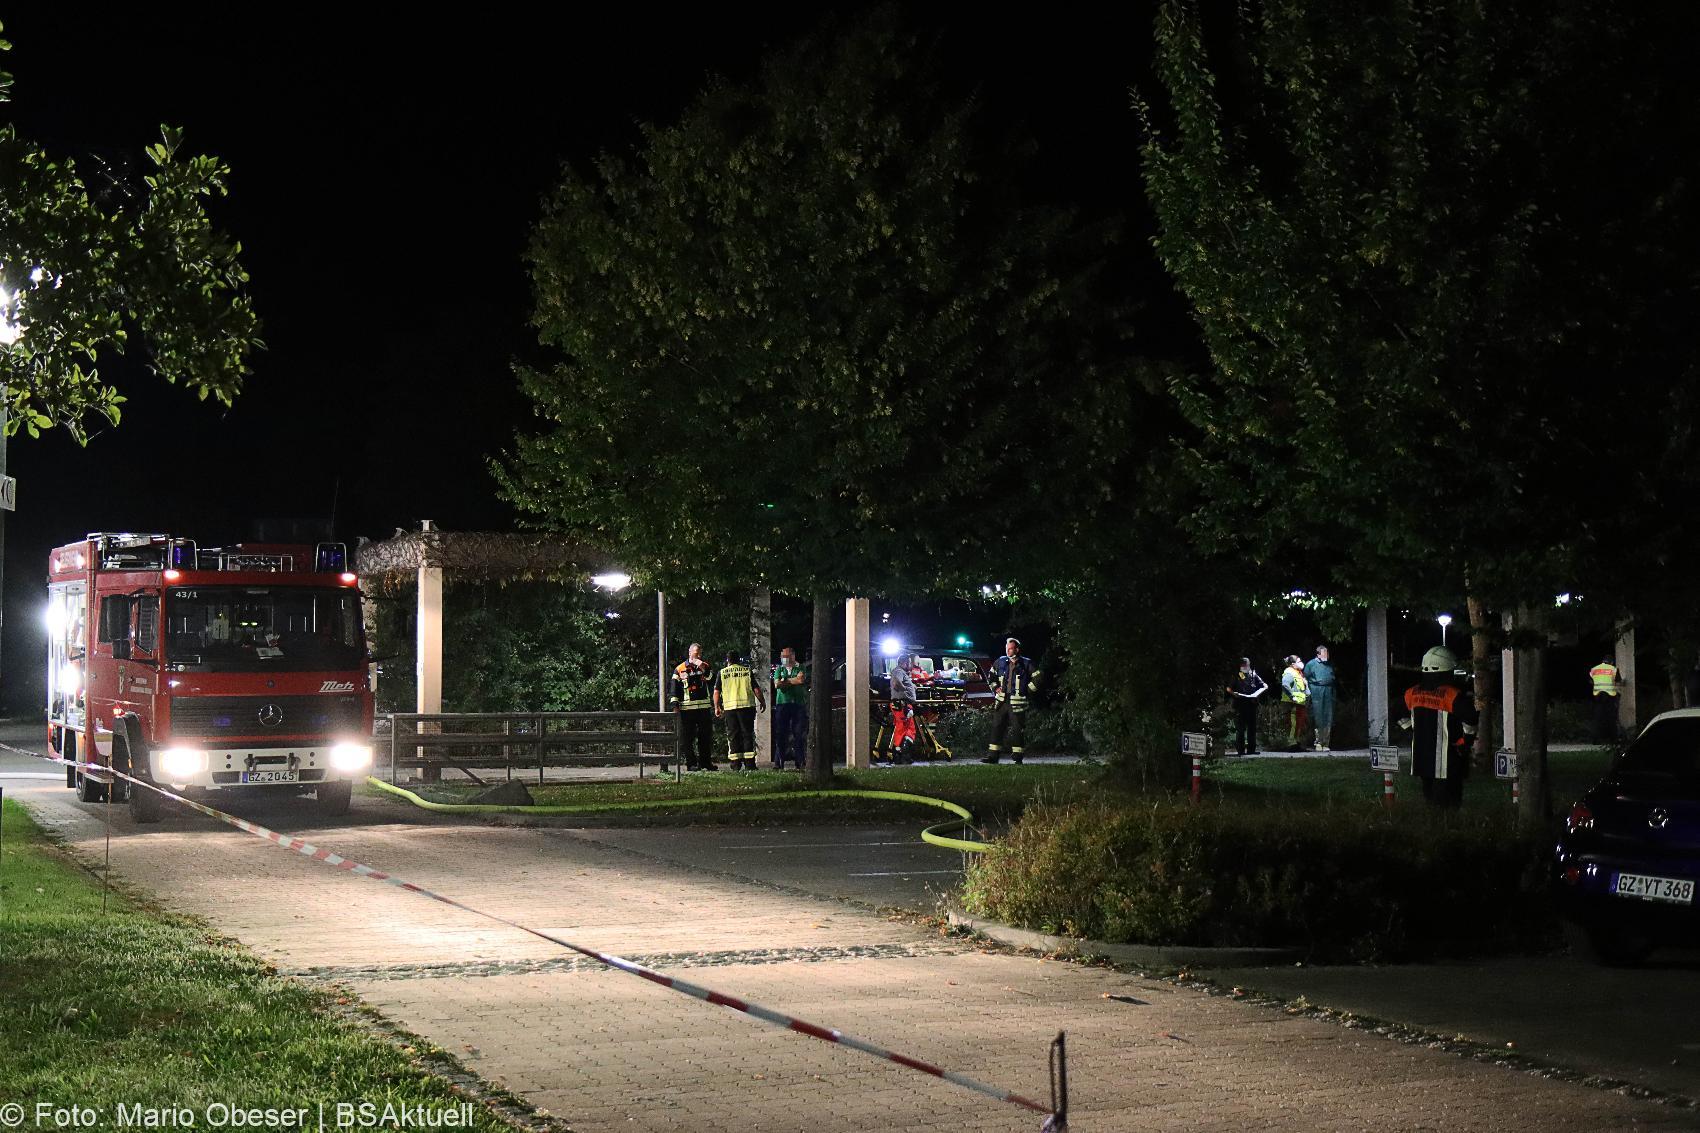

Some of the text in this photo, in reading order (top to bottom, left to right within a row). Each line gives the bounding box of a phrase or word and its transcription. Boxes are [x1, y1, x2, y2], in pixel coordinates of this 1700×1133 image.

[175, 591, 198, 599] 43/1
[319, 680, 355, 692] Metz
[248, 772, 294, 781] GZ 2045
[1619, 875, 1691, 899] GZ YT 368
